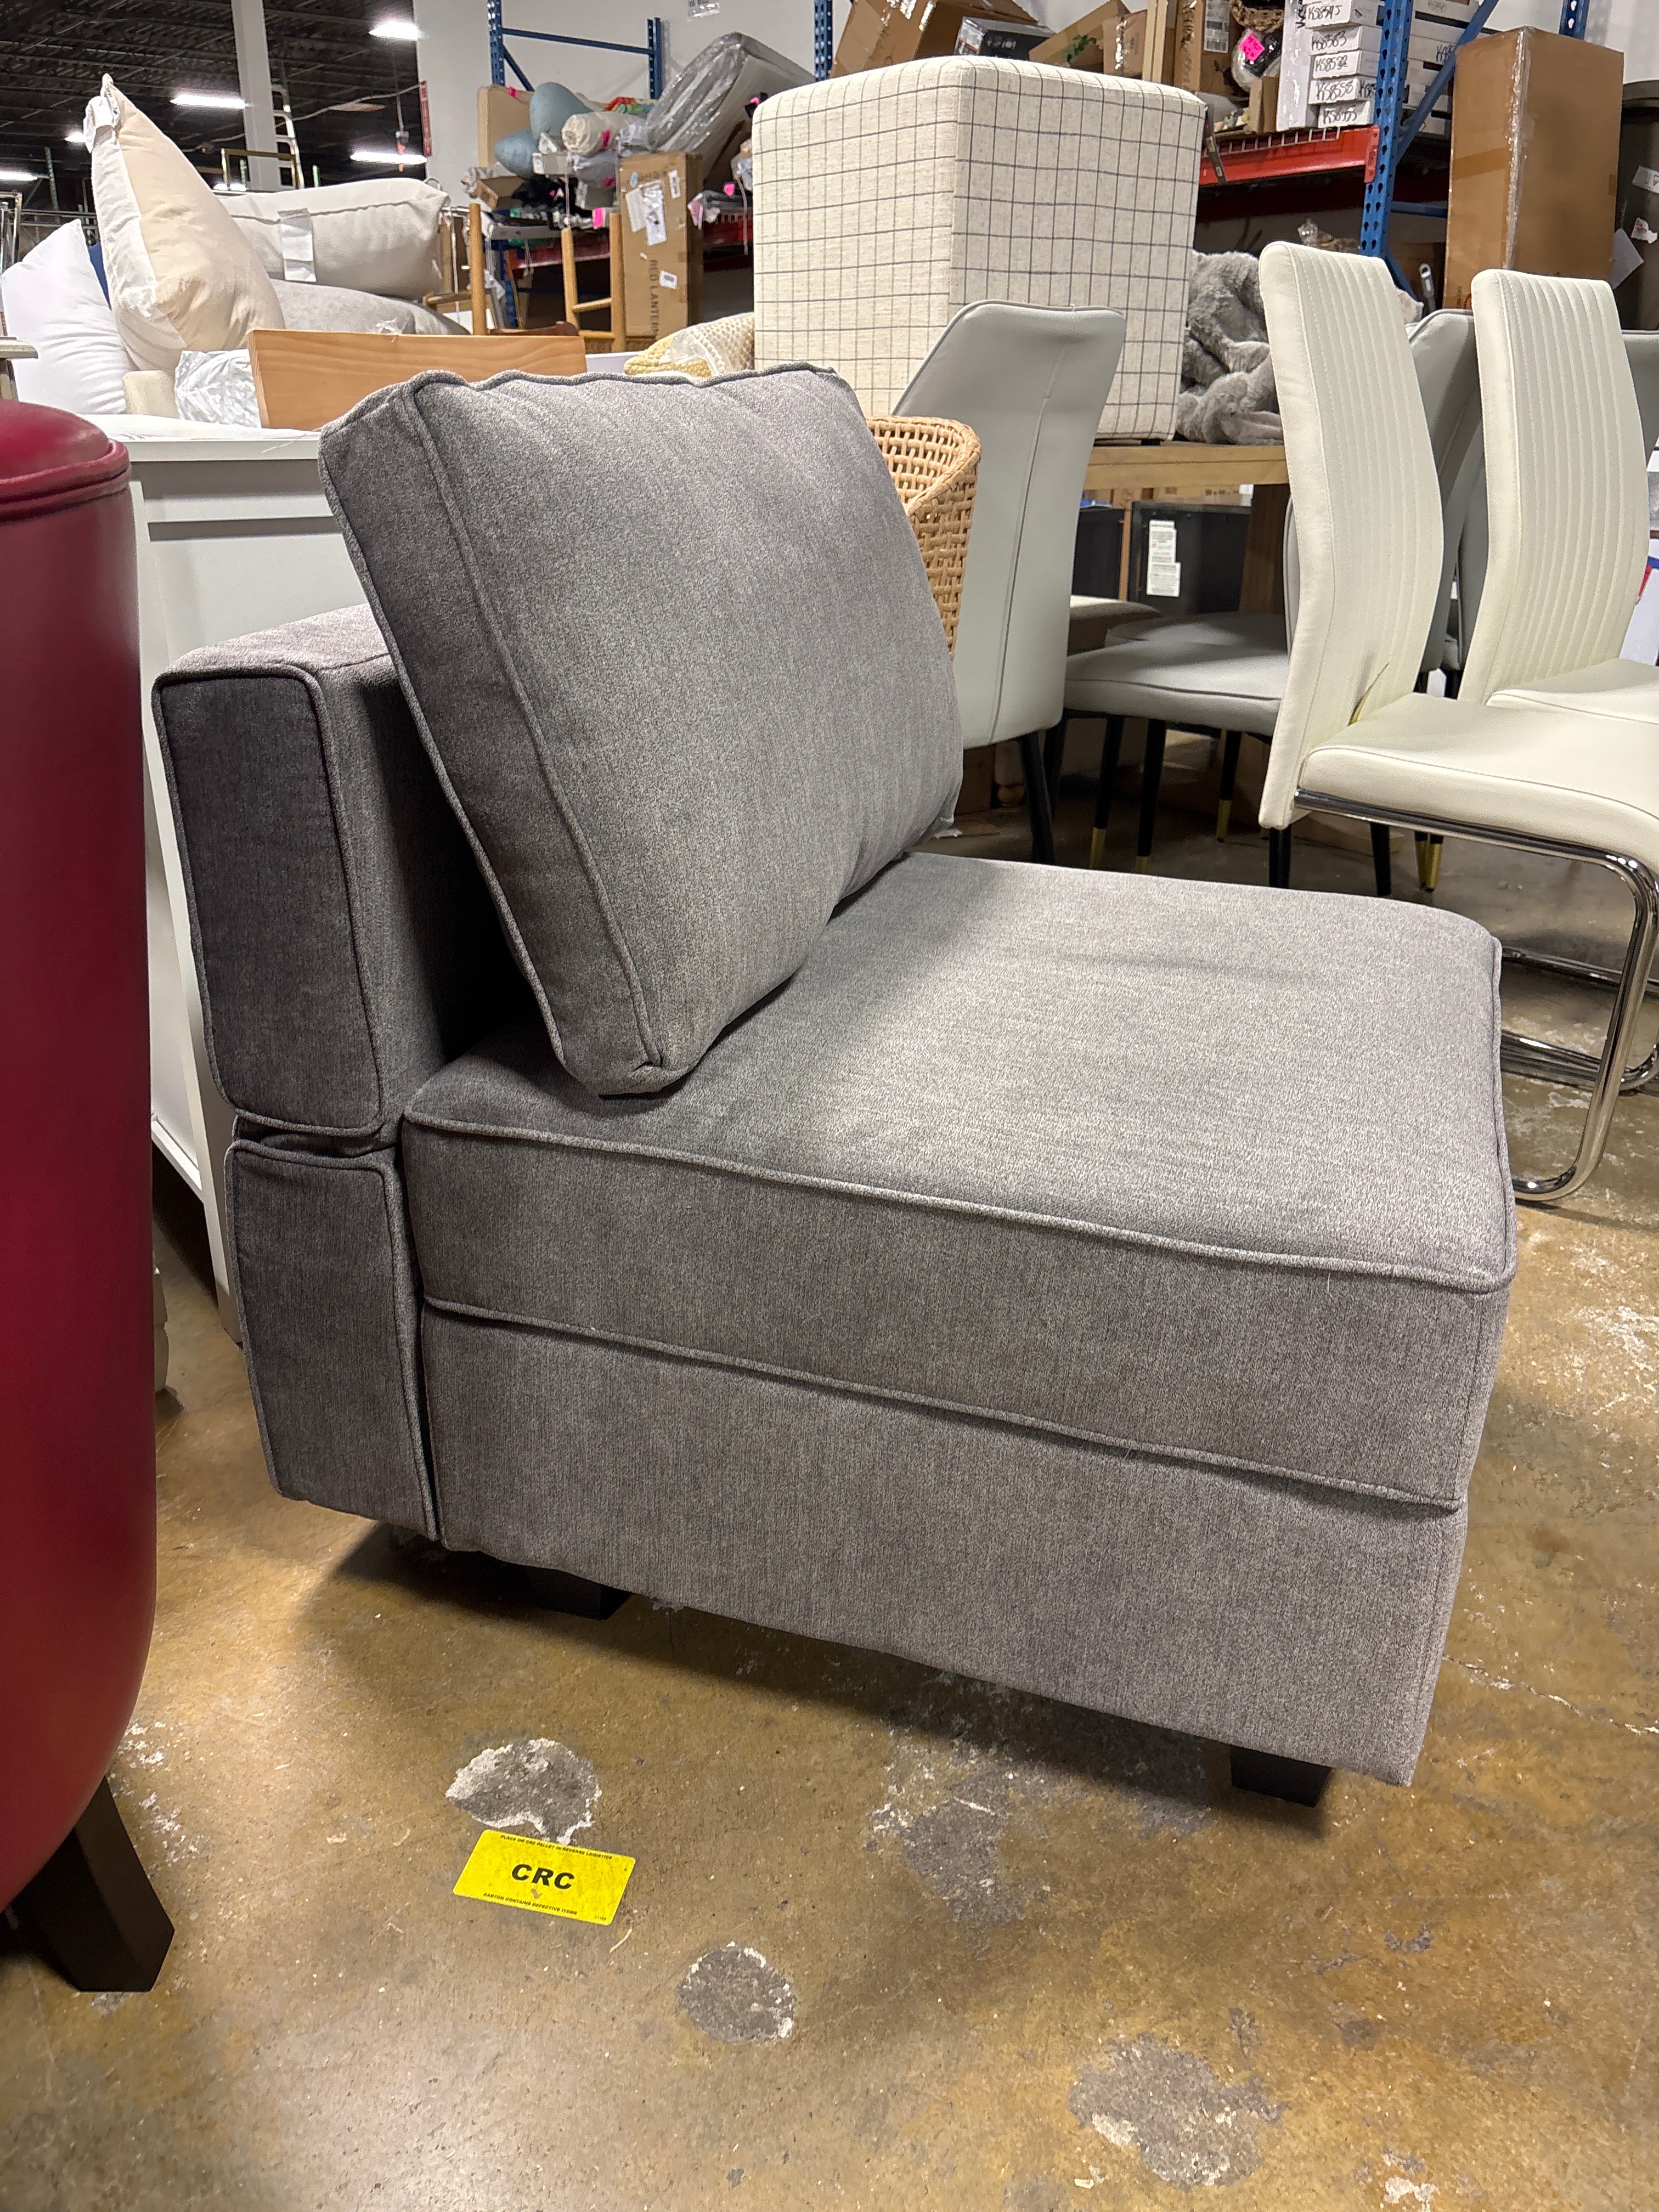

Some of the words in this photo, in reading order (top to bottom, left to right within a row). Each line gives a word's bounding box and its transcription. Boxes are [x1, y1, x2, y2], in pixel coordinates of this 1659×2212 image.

[585, 1851, 613, 1860] LOGISTICS
[512, 1864, 575, 1889] CRC
[483, 1892, 505, 1900] CARTON
[505, 1897, 531, 1906] CONTAINS
[532, 1903, 561, 1912] DEFECTIVE
